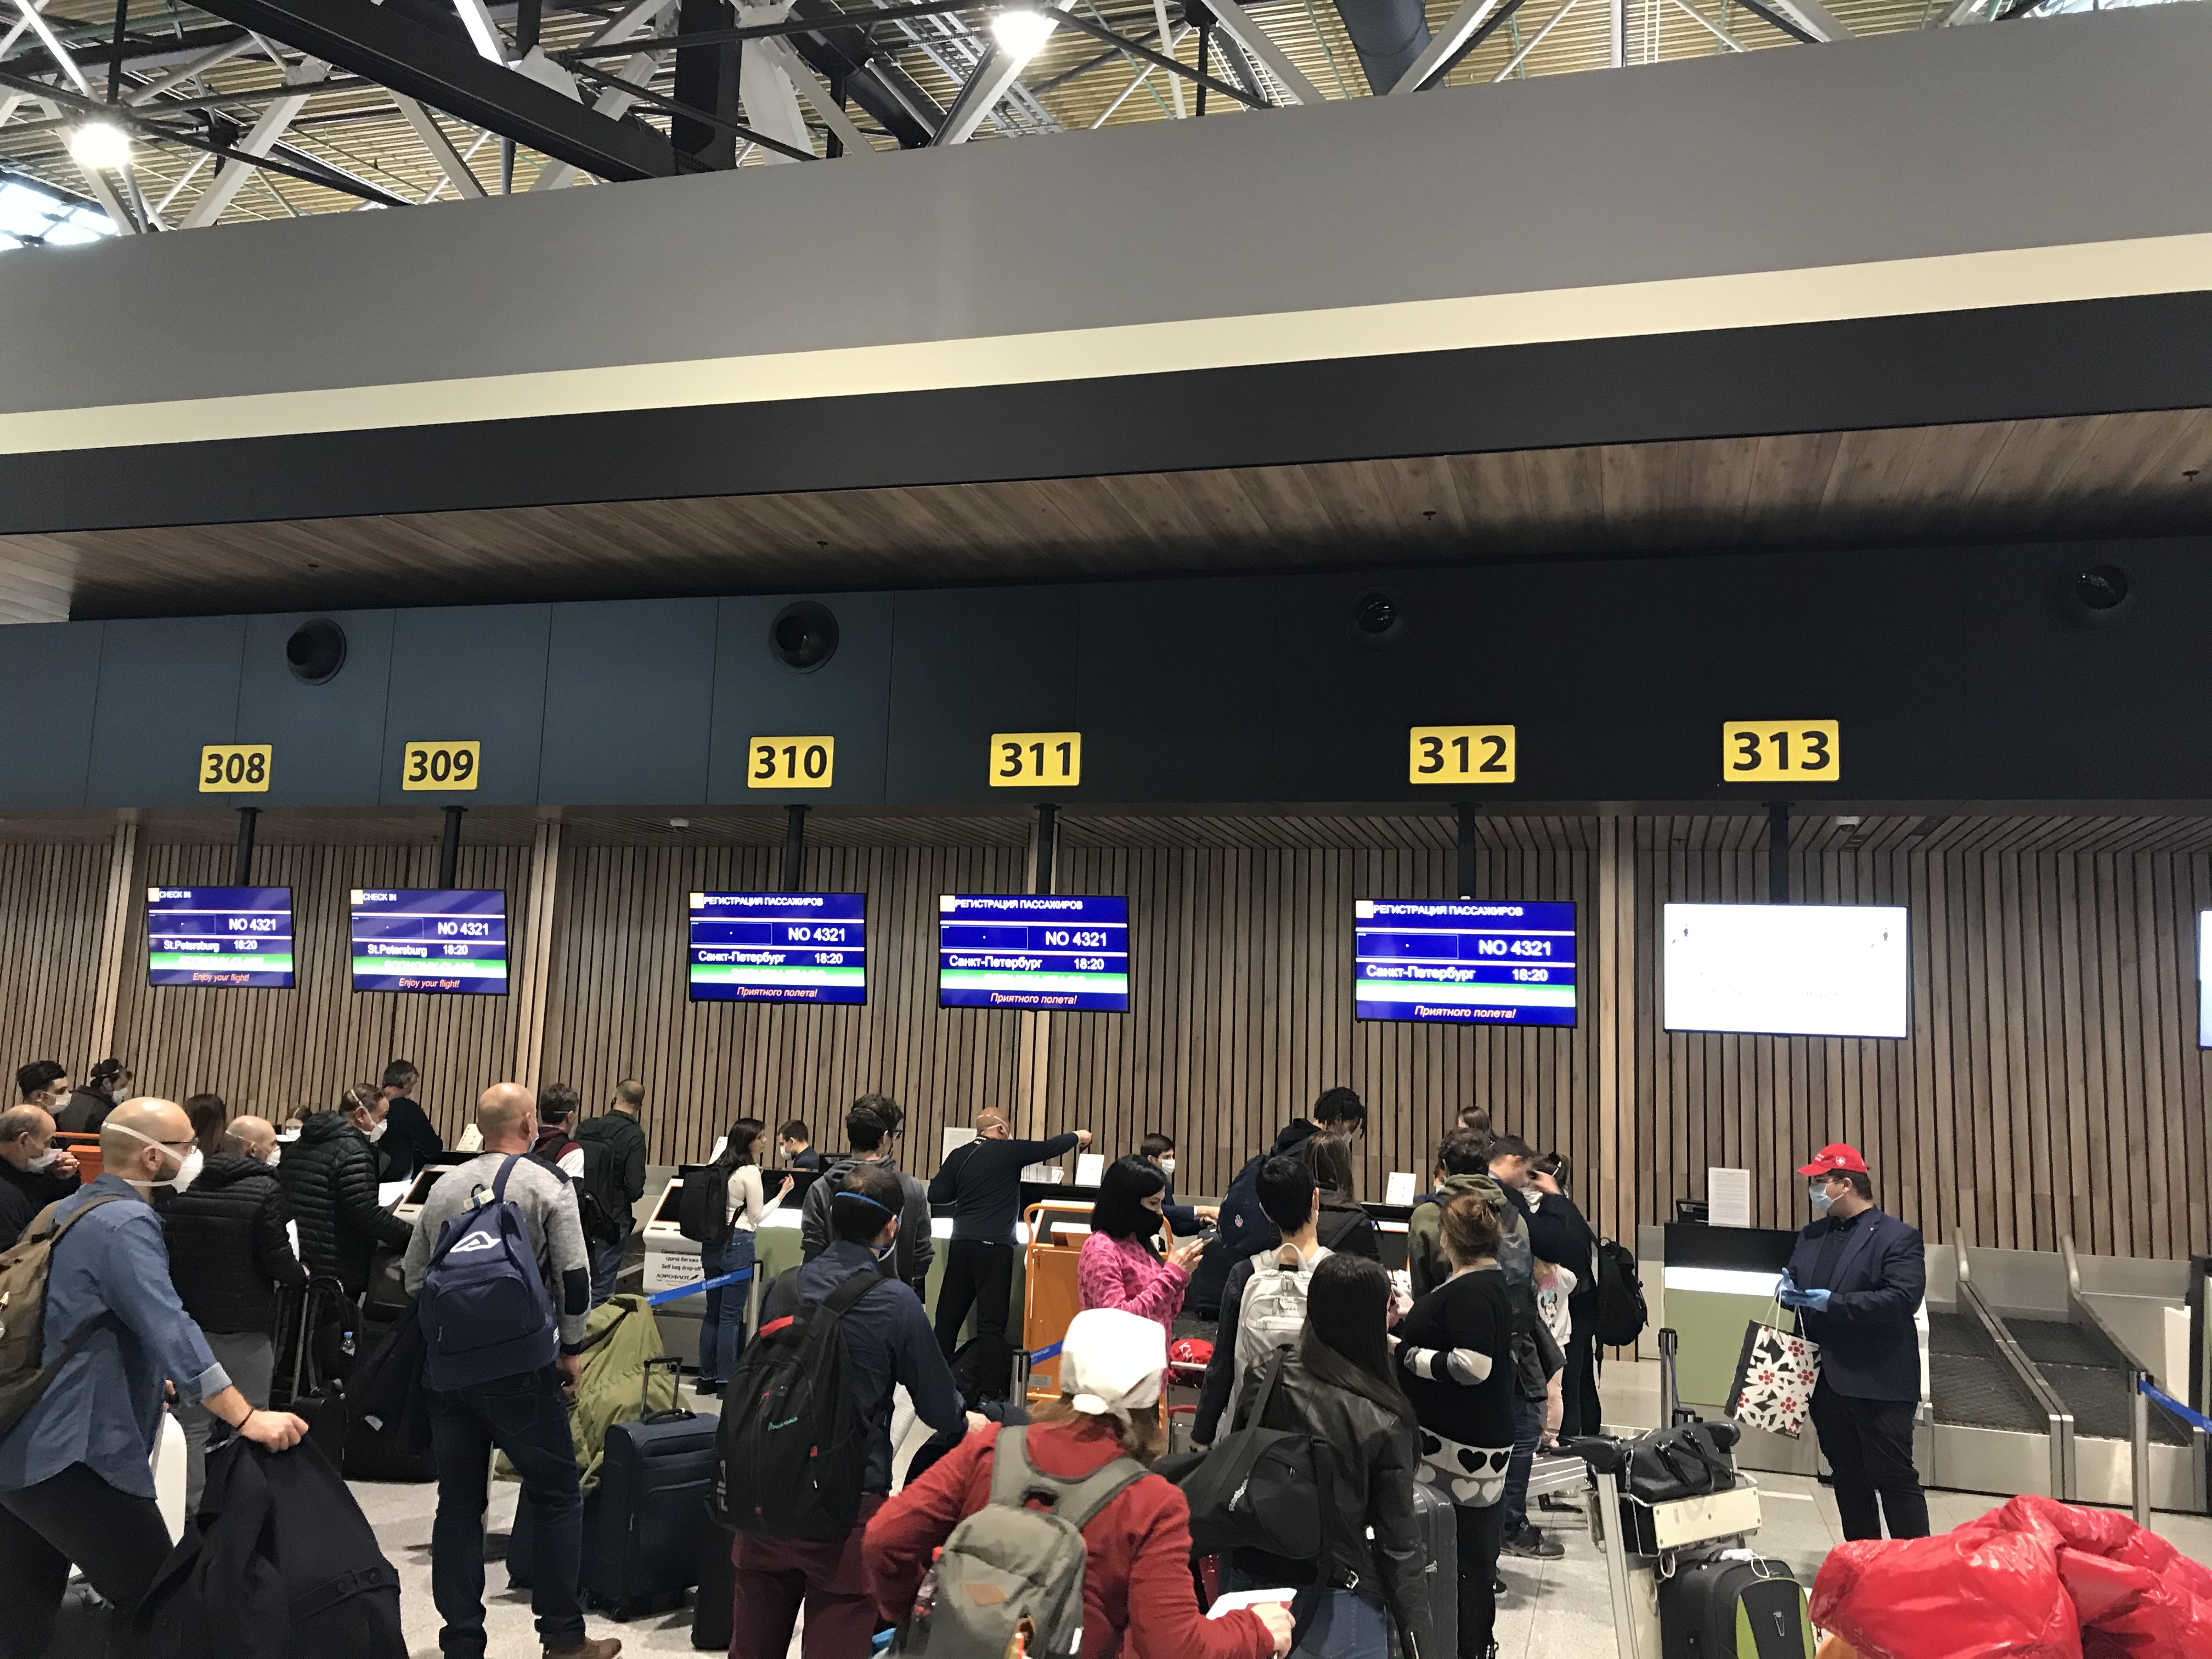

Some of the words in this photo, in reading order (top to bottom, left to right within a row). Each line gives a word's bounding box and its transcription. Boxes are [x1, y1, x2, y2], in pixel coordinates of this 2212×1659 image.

[1419, 736, 1506, 773] 312
[1734, 731, 1830, 770] 313
[409, 750, 474, 781] 309
[755, 746, 827, 778] 310
[1000, 742, 1070, 776] 311
[205, 753, 264, 783] 308
[363, 893, 387, 901] CHECK
[704, 896, 763, 906] РЕГИСТРАЦИЯ
[764, 898, 823, 906] ПАССАЖИРОВ
[955, 899, 1018, 910] РЕГИСТРАЦИЯ
[1020, 900, 1083, 910] ПАССАЖИРОВ
[1373, 904, 1447, 917] РЕГИСТРАЦИЯ
[1449, 905, 1523, 916] ПАССАЖИРОВ
[229, 918, 247, 930] NO
[250, 919, 276, 930] 4321
[438, 922, 458, 935] NO
[460, 922, 488, 935] 4321
[788, 928, 810, 940] NO
[814, 928, 844, 941] 4321
[1046, 931, 1069, 945] NO
[1073, 932, 1106, 946] 4321
[234, 940, 257, 950] 18:20
[443, 945, 468, 955] 18:20
[1479, 940, 1507, 955] NO
[1510, 941, 1550, 956] 4321
[698, 951, 786, 965] Санкт-Петербург
[815, 953, 843, 964] 18:20
[949, 955, 1042, 970] Санкт-Петербург
[1074, 958, 1104, 970] 18:20
[193, 973, 212, 983] Enjoy
[213, 974, 230, 983] your
[230, 974, 250, 983] flight!
[1366, 964, 1476, 982] Санкт-Петербург
[1513, 968, 1548, 981] 18:20
[399, 978, 420, 988] Enjoy
[439, 979, 460, 990] flight!
[737, 986, 782, 997] Приятного
[783, 988, 818, 997] полета!
[990, 992, 1039, 1004] Приятного
[1041, 995, 1077, 1005] полета!
[1414, 1005, 1471, 1019] Приятного
[1474, 1008, 1516, 1019] полета!
